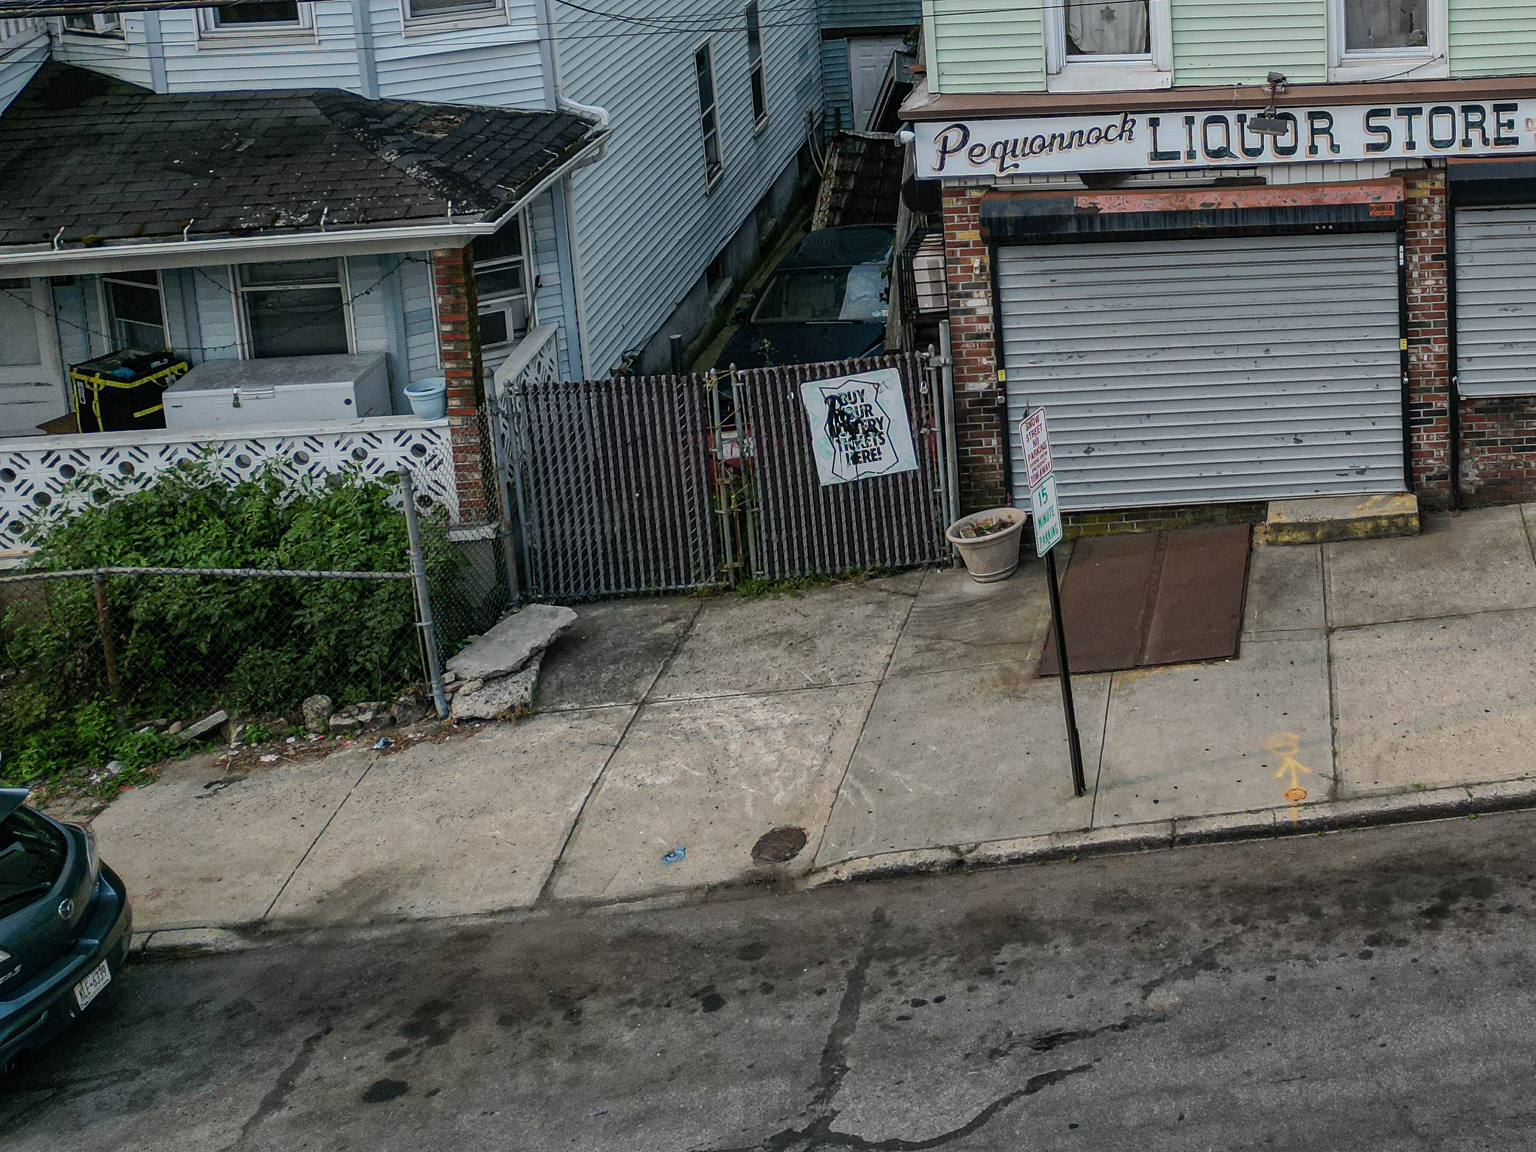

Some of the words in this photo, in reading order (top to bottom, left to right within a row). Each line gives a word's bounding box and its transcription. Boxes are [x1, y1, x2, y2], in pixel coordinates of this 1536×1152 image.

[932, 112, 1137, 176] Pequonnock
[1147, 110, 1341, 165] LIQUOR
[1363, 103, 1519, 155] STORE
[1026, 423, 1042, 443] STREET
[1032, 437, 1040, 448] NO
[1027, 440, 1048, 463] PARKING
[1038, 487, 1048, 507] 15
[1038, 504, 1055, 529] MINUTE
[1038, 523, 1059, 550] PARKING
